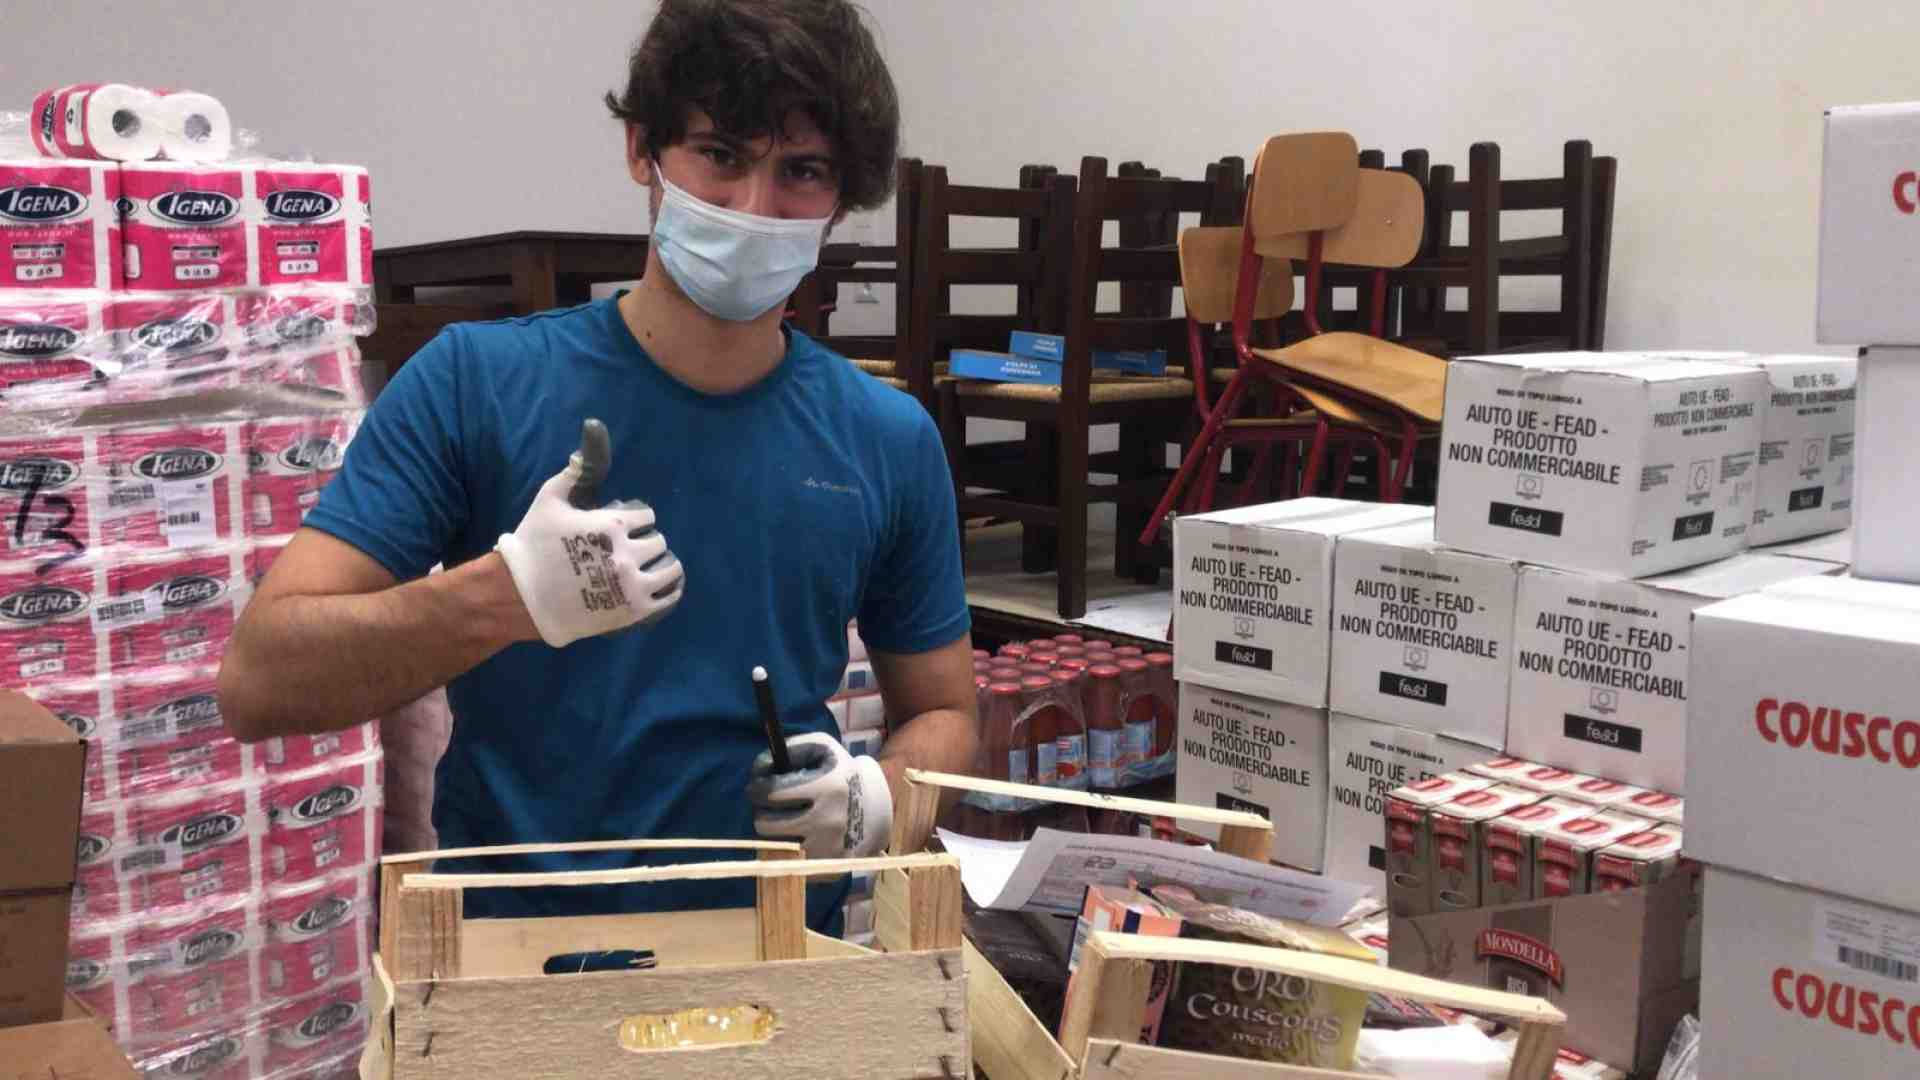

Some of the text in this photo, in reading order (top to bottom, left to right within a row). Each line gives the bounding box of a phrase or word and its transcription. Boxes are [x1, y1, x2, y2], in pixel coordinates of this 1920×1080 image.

[8, 191, 71, 212] IGENA
[168, 194, 227, 216] IGENA
[273, 194, 325, 213] IGENA
[1466, 403, 1512, 426] AIUTO
[1517, 410, 1538, 430] UE
[1554, 414, 1597, 437] FEAD
[1493, 428, 1577, 456] PRODOTTO
[152, 455, 208, 475] IGENA
[1449, 443, 1483, 463] NON
[1487, 448, 1621, 485] COMMERCIABILE
[1510, 509, 1542, 529] fead
[1191, 556, 1226, 575] AIUTO
[1230, 561, 1246, 578] UE
[1259, 565, 1291, 584] FEAD
[1213, 577, 1278, 601] PRODOTTO
[1354, 579, 1396, 600] AIUTO
[1401, 586, 1420, 605] UE
[1436, 592, 1474, 614] FEAD
[13, 594, 73, 615] IGENA
[1180, 590, 1313, 625] NON COMMERCIABILE
[1380, 602, 1458, 631] PRODOTTO
[1341, 614, 1498, 659] NON COMMERCIABILE
[1536, 611, 1583, 637] AIUTO
[1588, 620, 1610, 642] UE
[1628, 627, 1673, 653] FEAD
[1564, 638, 1652, 671] PRODOTTO
[1519, 651, 1687, 701] NON COMMERCIABIL
[1192, 708, 1223, 729] AIUTO
[1226, 717, 1241, 735] UE
[1253, 726, 1285, 747] FEAD
[1586, 721, 1619, 744] fead
[1212, 732, 1272, 761] PRODOTTO
[1184, 739, 1311, 787] NON COMMERCIABILE
[1345, 751, 1384, 776] AIUTO
[1388, 762, 1406, 783] UE
[1335, 785, 1360, 808] NON
[1485, 931, 1555, 971] MONDELLA
